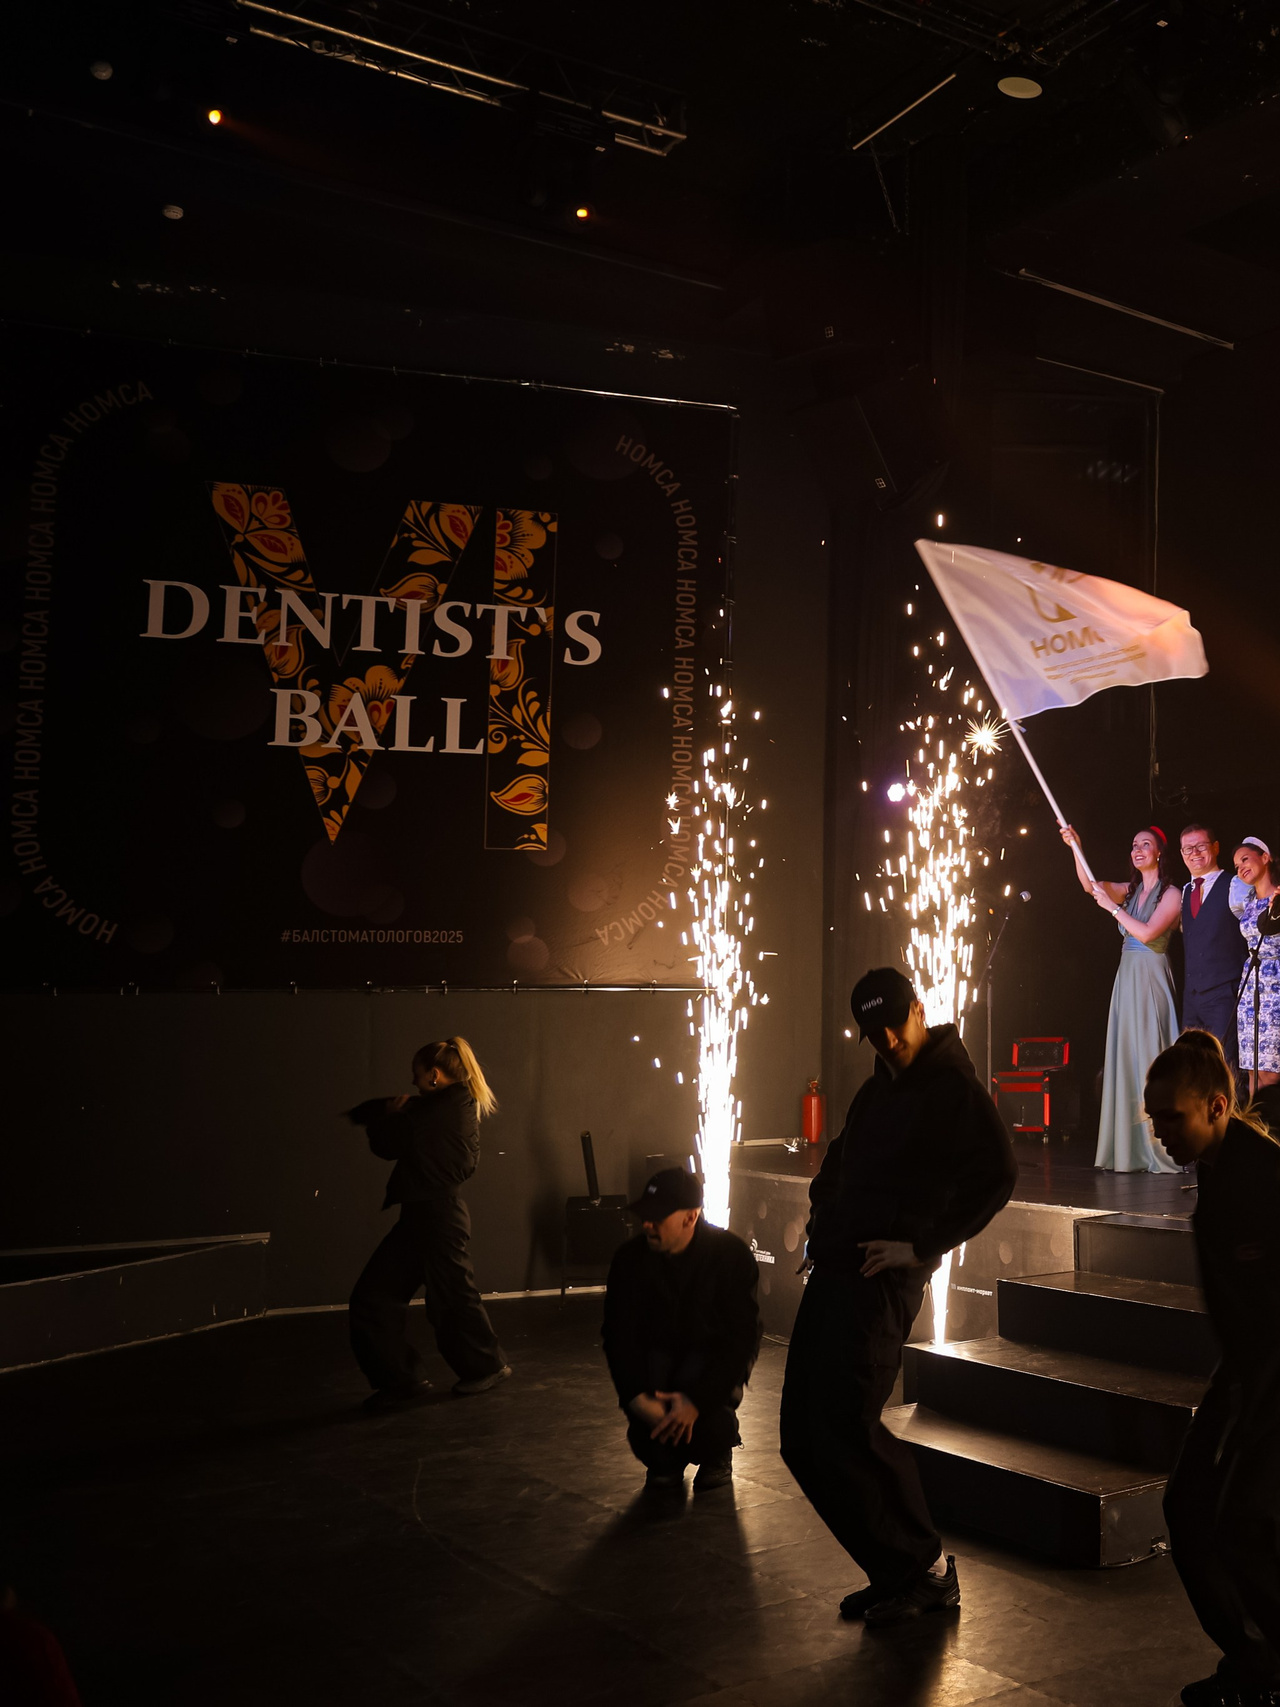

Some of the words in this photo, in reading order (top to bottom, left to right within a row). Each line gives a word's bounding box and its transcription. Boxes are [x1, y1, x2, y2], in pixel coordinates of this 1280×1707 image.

[267, 687, 488, 756] BALL
[280, 929, 464, 944] #БАЛСТОМАТОЛОГОВ2025
[861, 996, 883, 1012] HUGO
